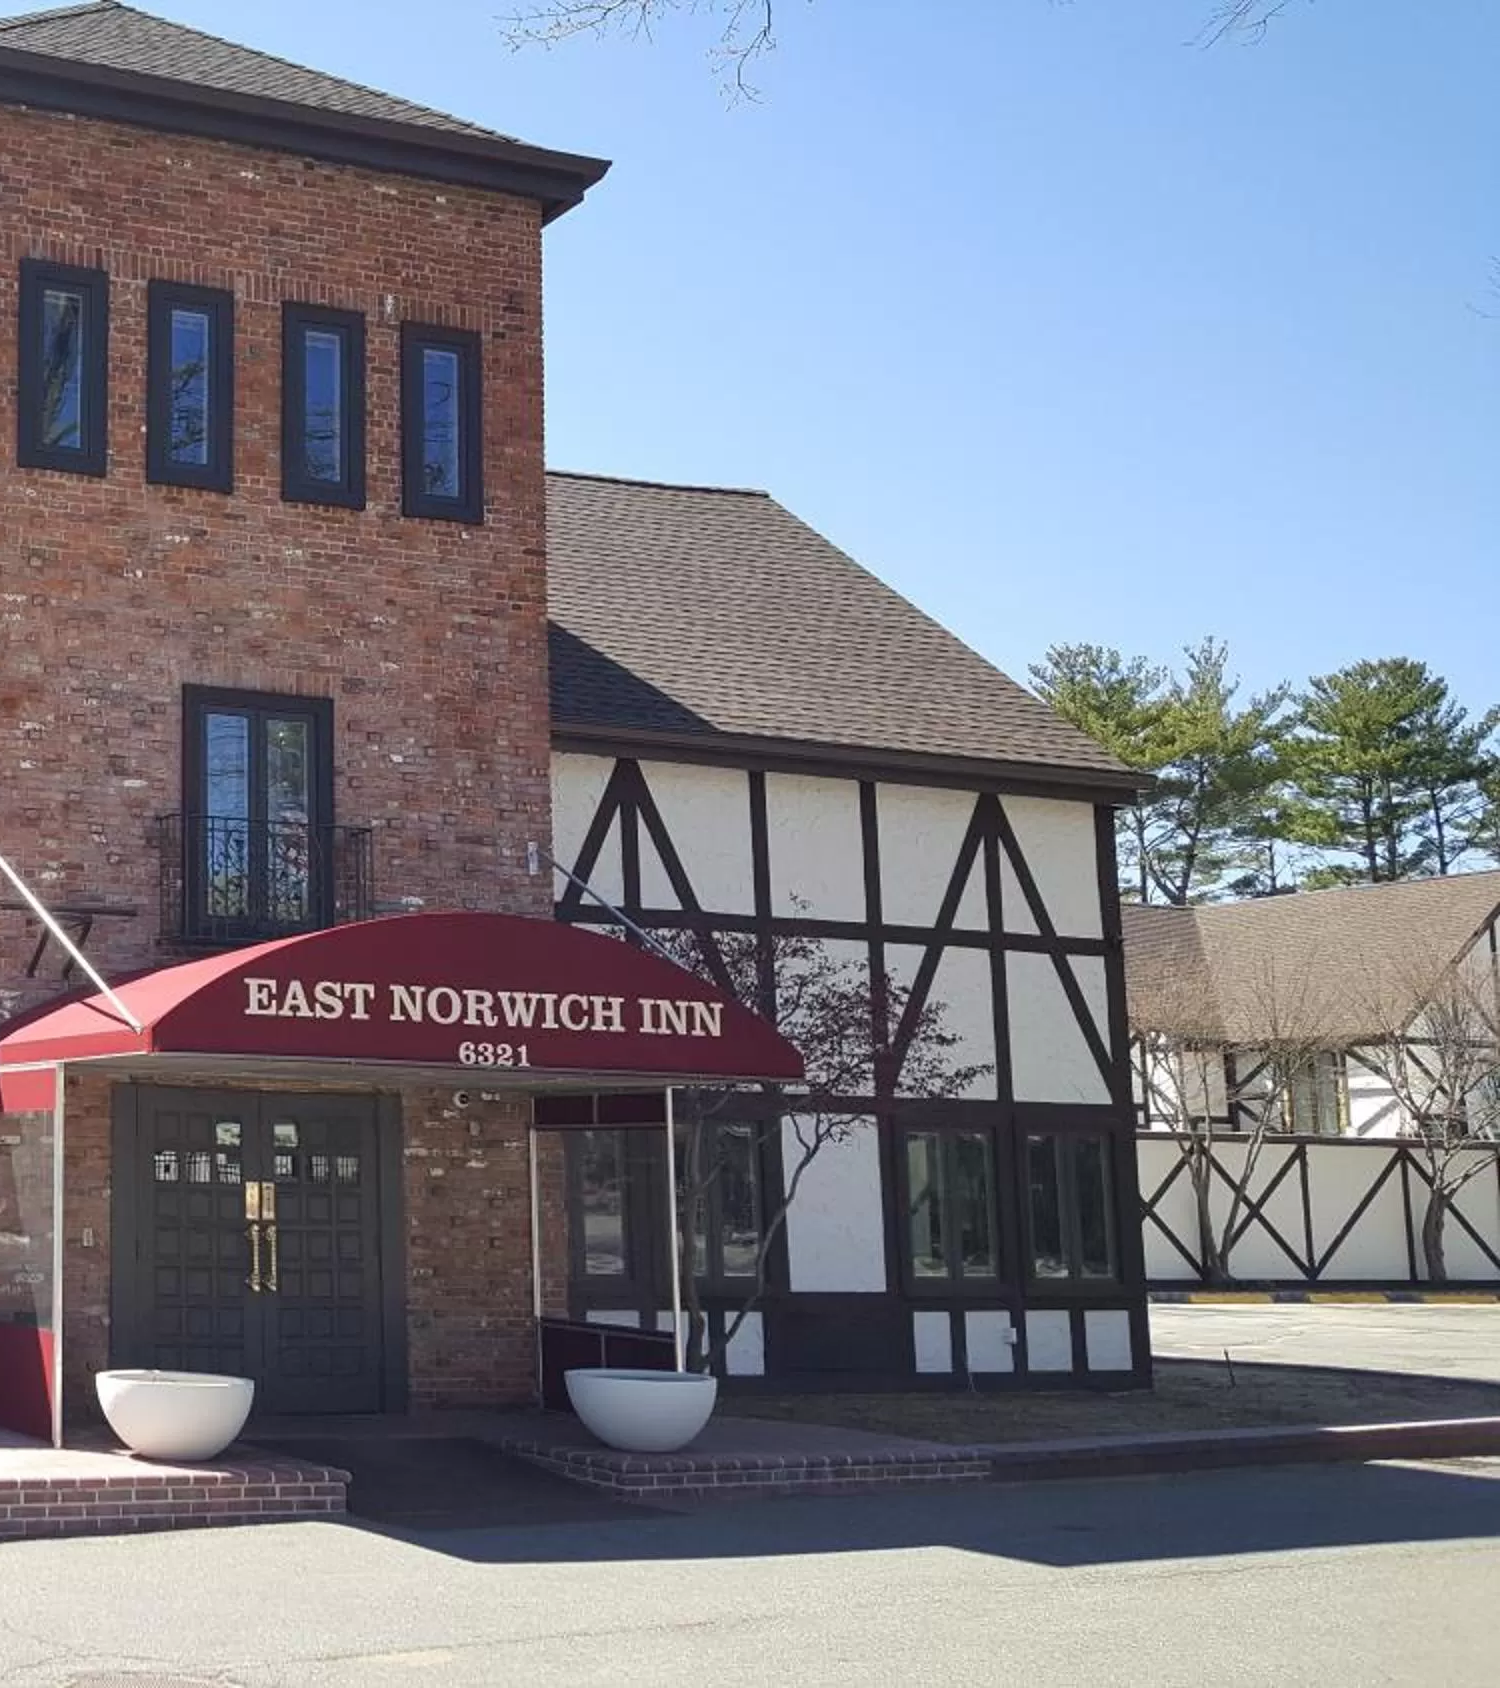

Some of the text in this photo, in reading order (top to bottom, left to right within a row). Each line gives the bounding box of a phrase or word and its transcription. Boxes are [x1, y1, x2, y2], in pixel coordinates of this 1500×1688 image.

[243, 977, 724, 1037] EAST NORWICH INN
[458, 1041, 531, 1067] 6321
